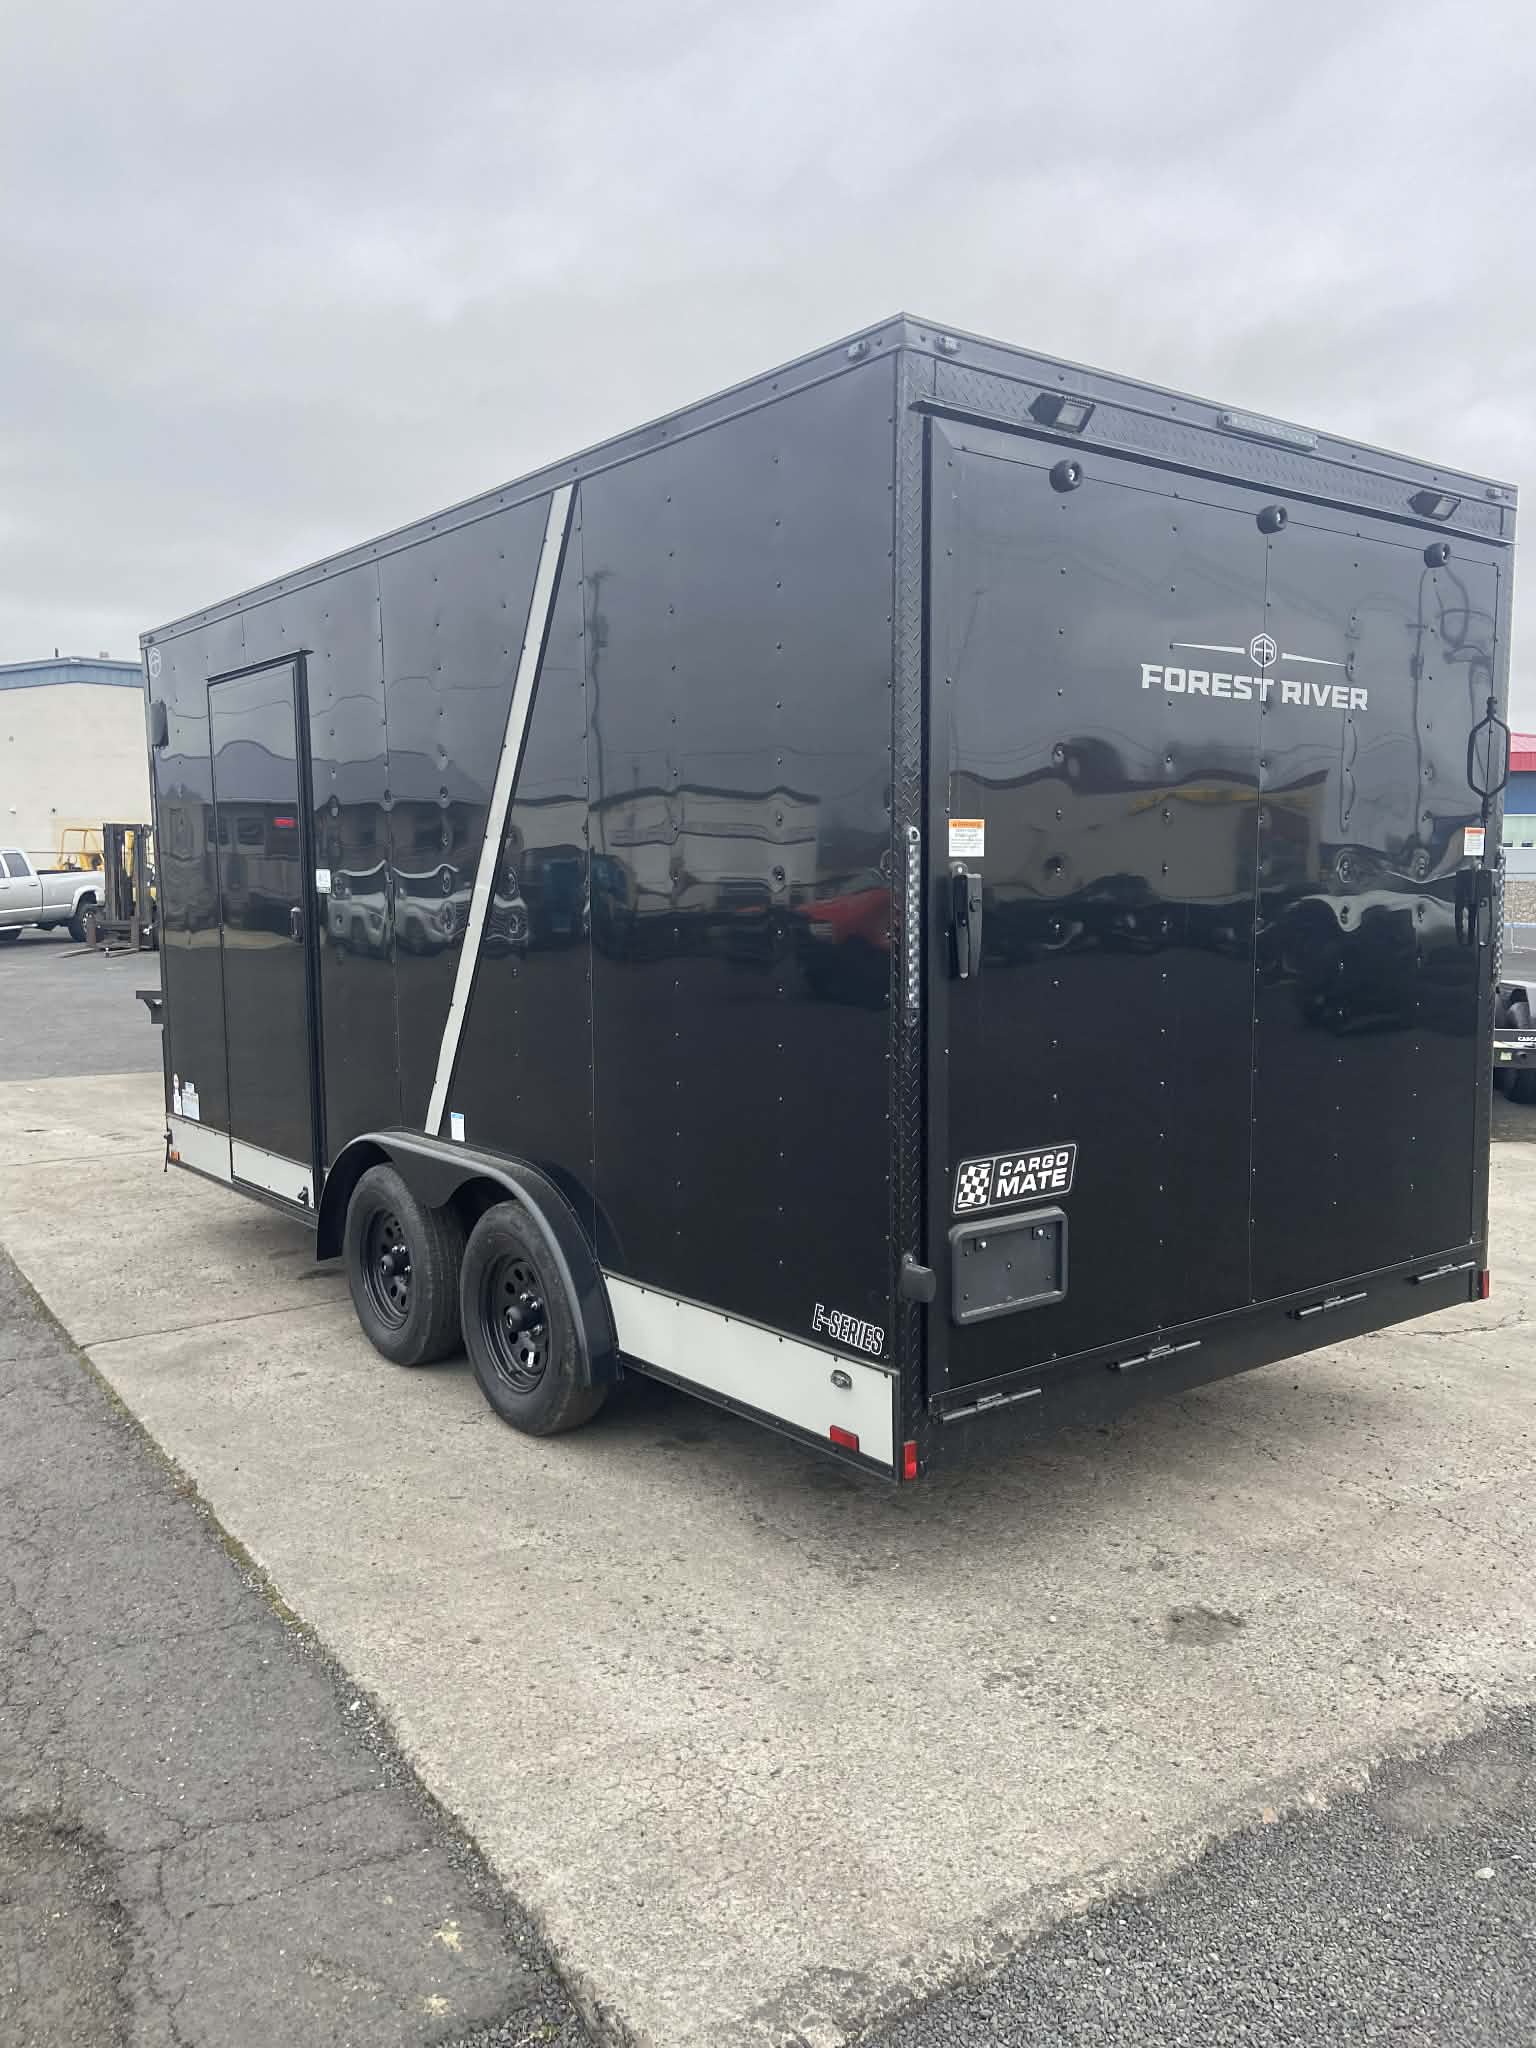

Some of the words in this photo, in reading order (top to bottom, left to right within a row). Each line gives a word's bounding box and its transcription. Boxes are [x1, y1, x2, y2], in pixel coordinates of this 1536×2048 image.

[1141, 663, 1274, 702] FOREST
[1280, 680, 1368, 711] RIVER
[996, 1167, 1068, 1198] MATE
[1000, 1151, 1069, 1177] CARGO
[812, 1303, 885, 1355] E-SERIES
